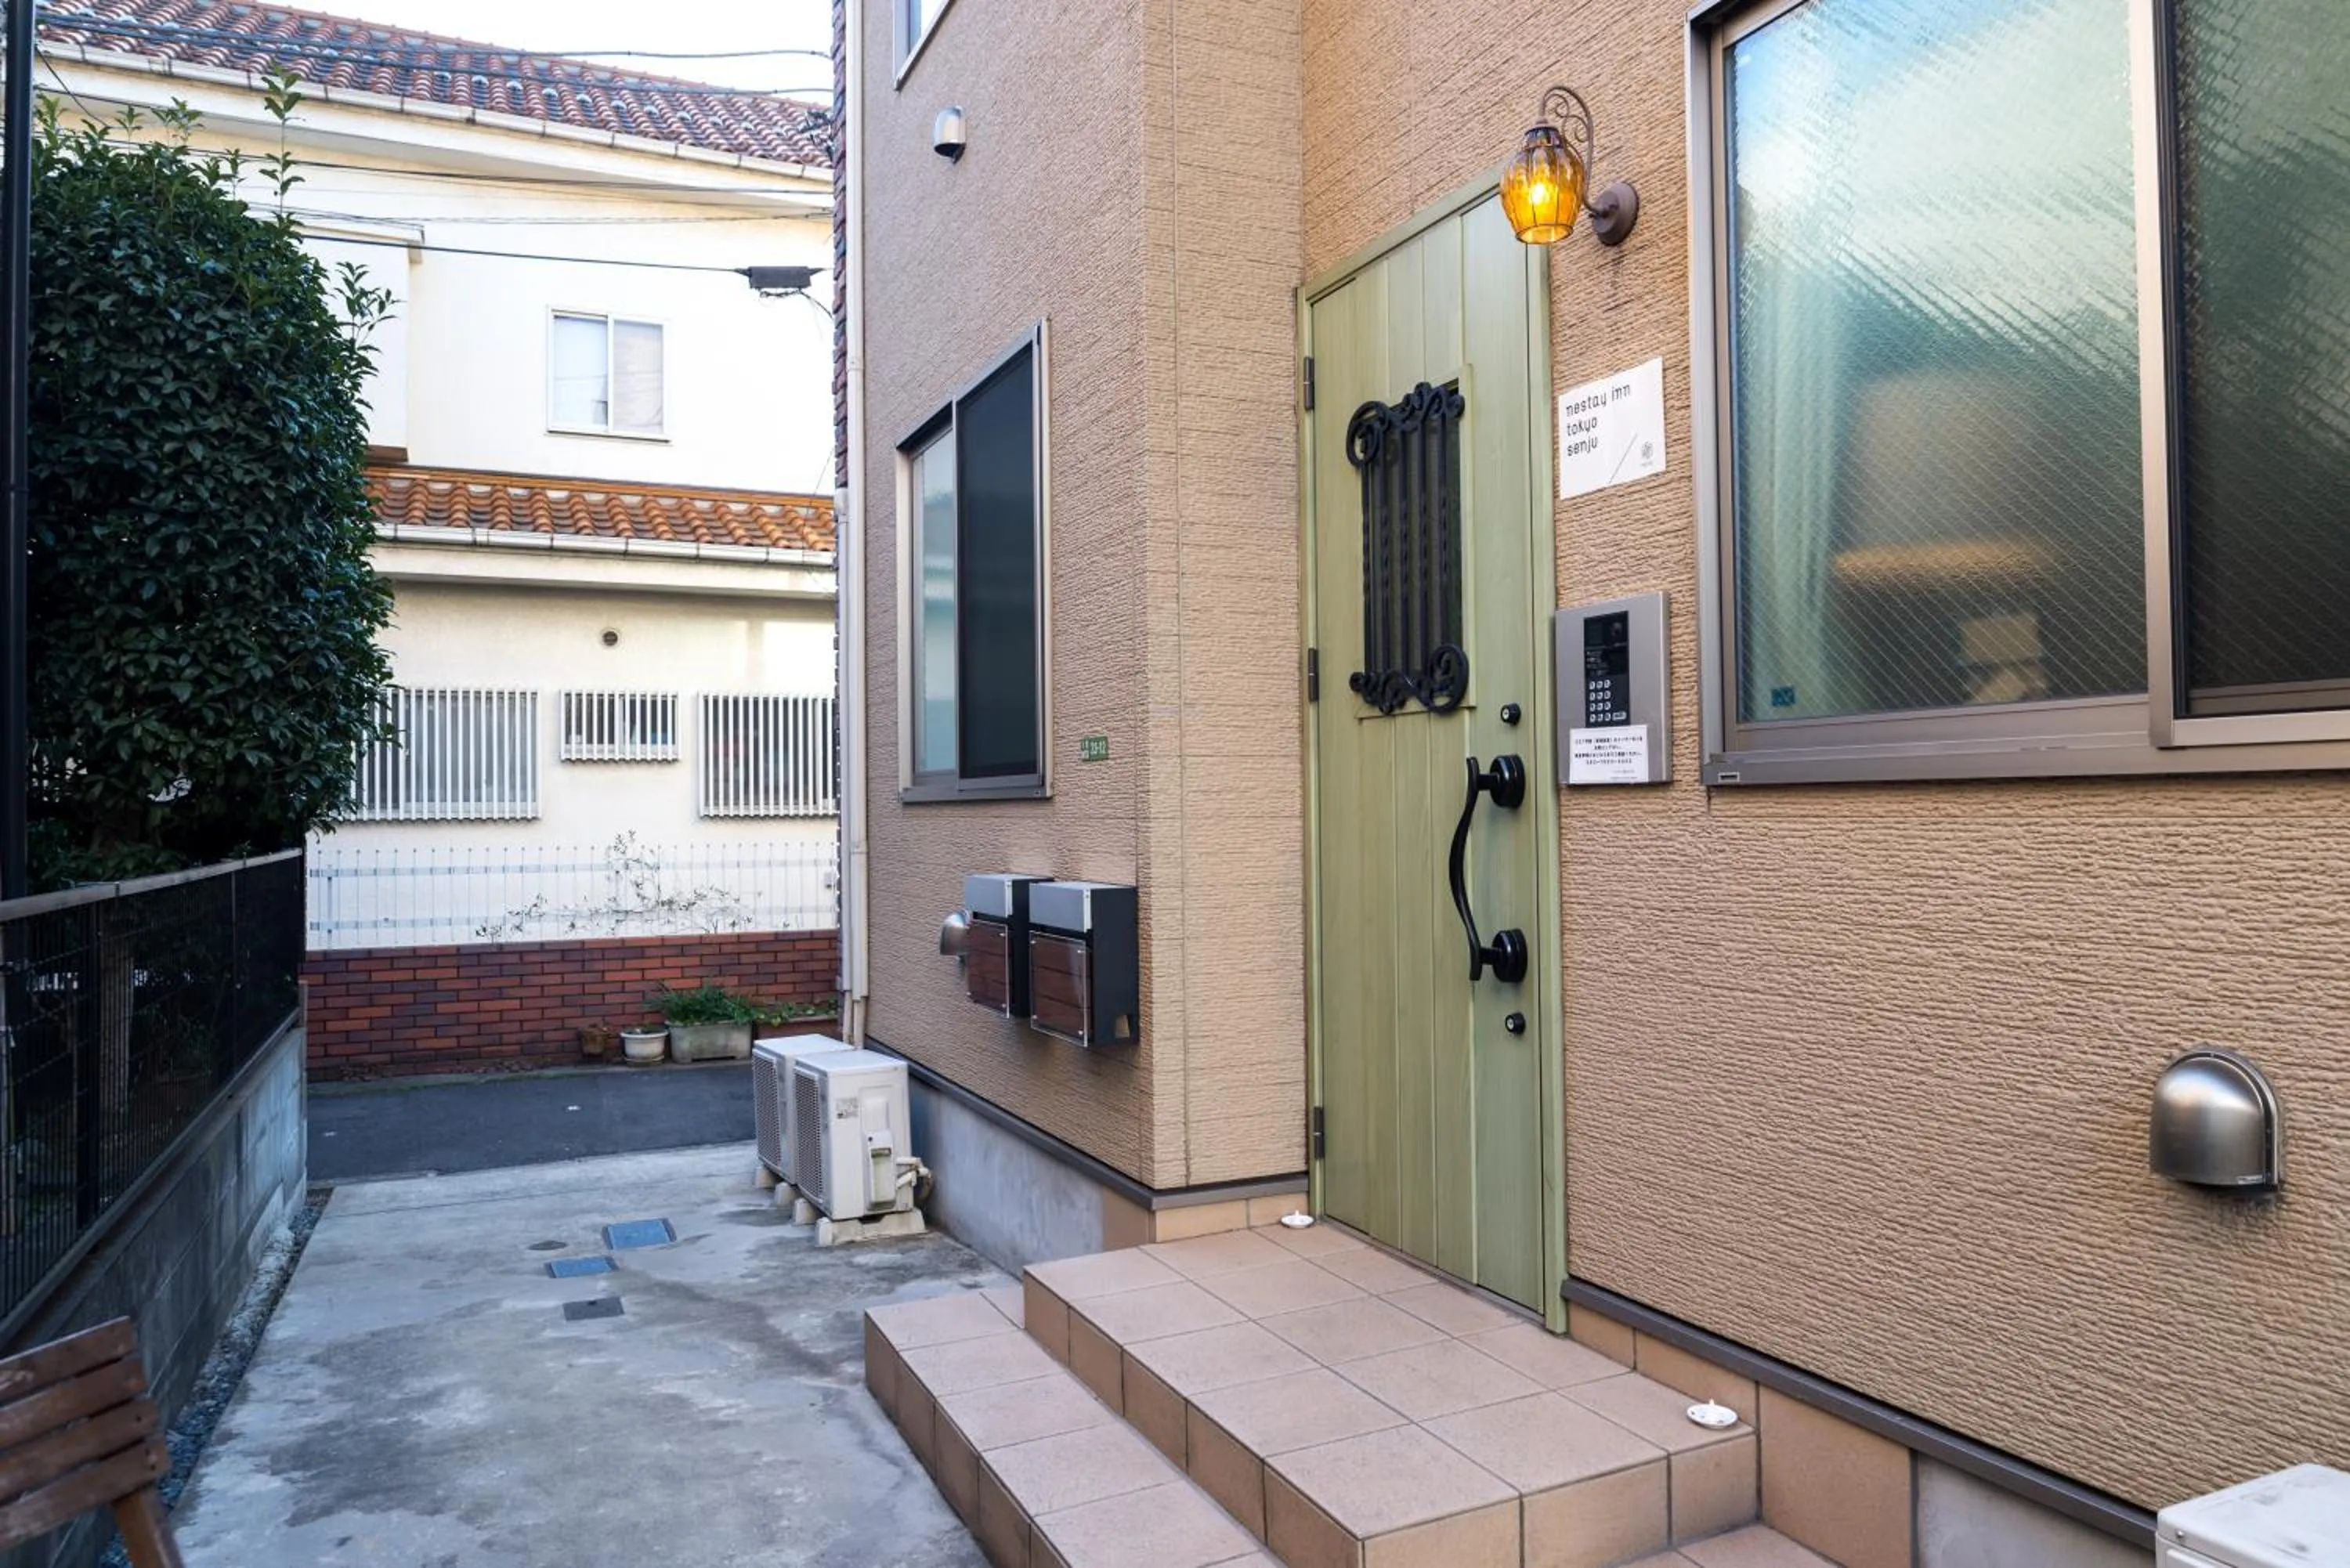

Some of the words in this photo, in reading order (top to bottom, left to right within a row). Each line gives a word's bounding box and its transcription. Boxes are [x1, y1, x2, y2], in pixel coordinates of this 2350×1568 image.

[1566, 392, 1607, 417] nestay
[1611, 385, 1630, 401] inn
[1567, 417, 1597, 436] tokyo
[1567, 436, 1597, 457] senju
